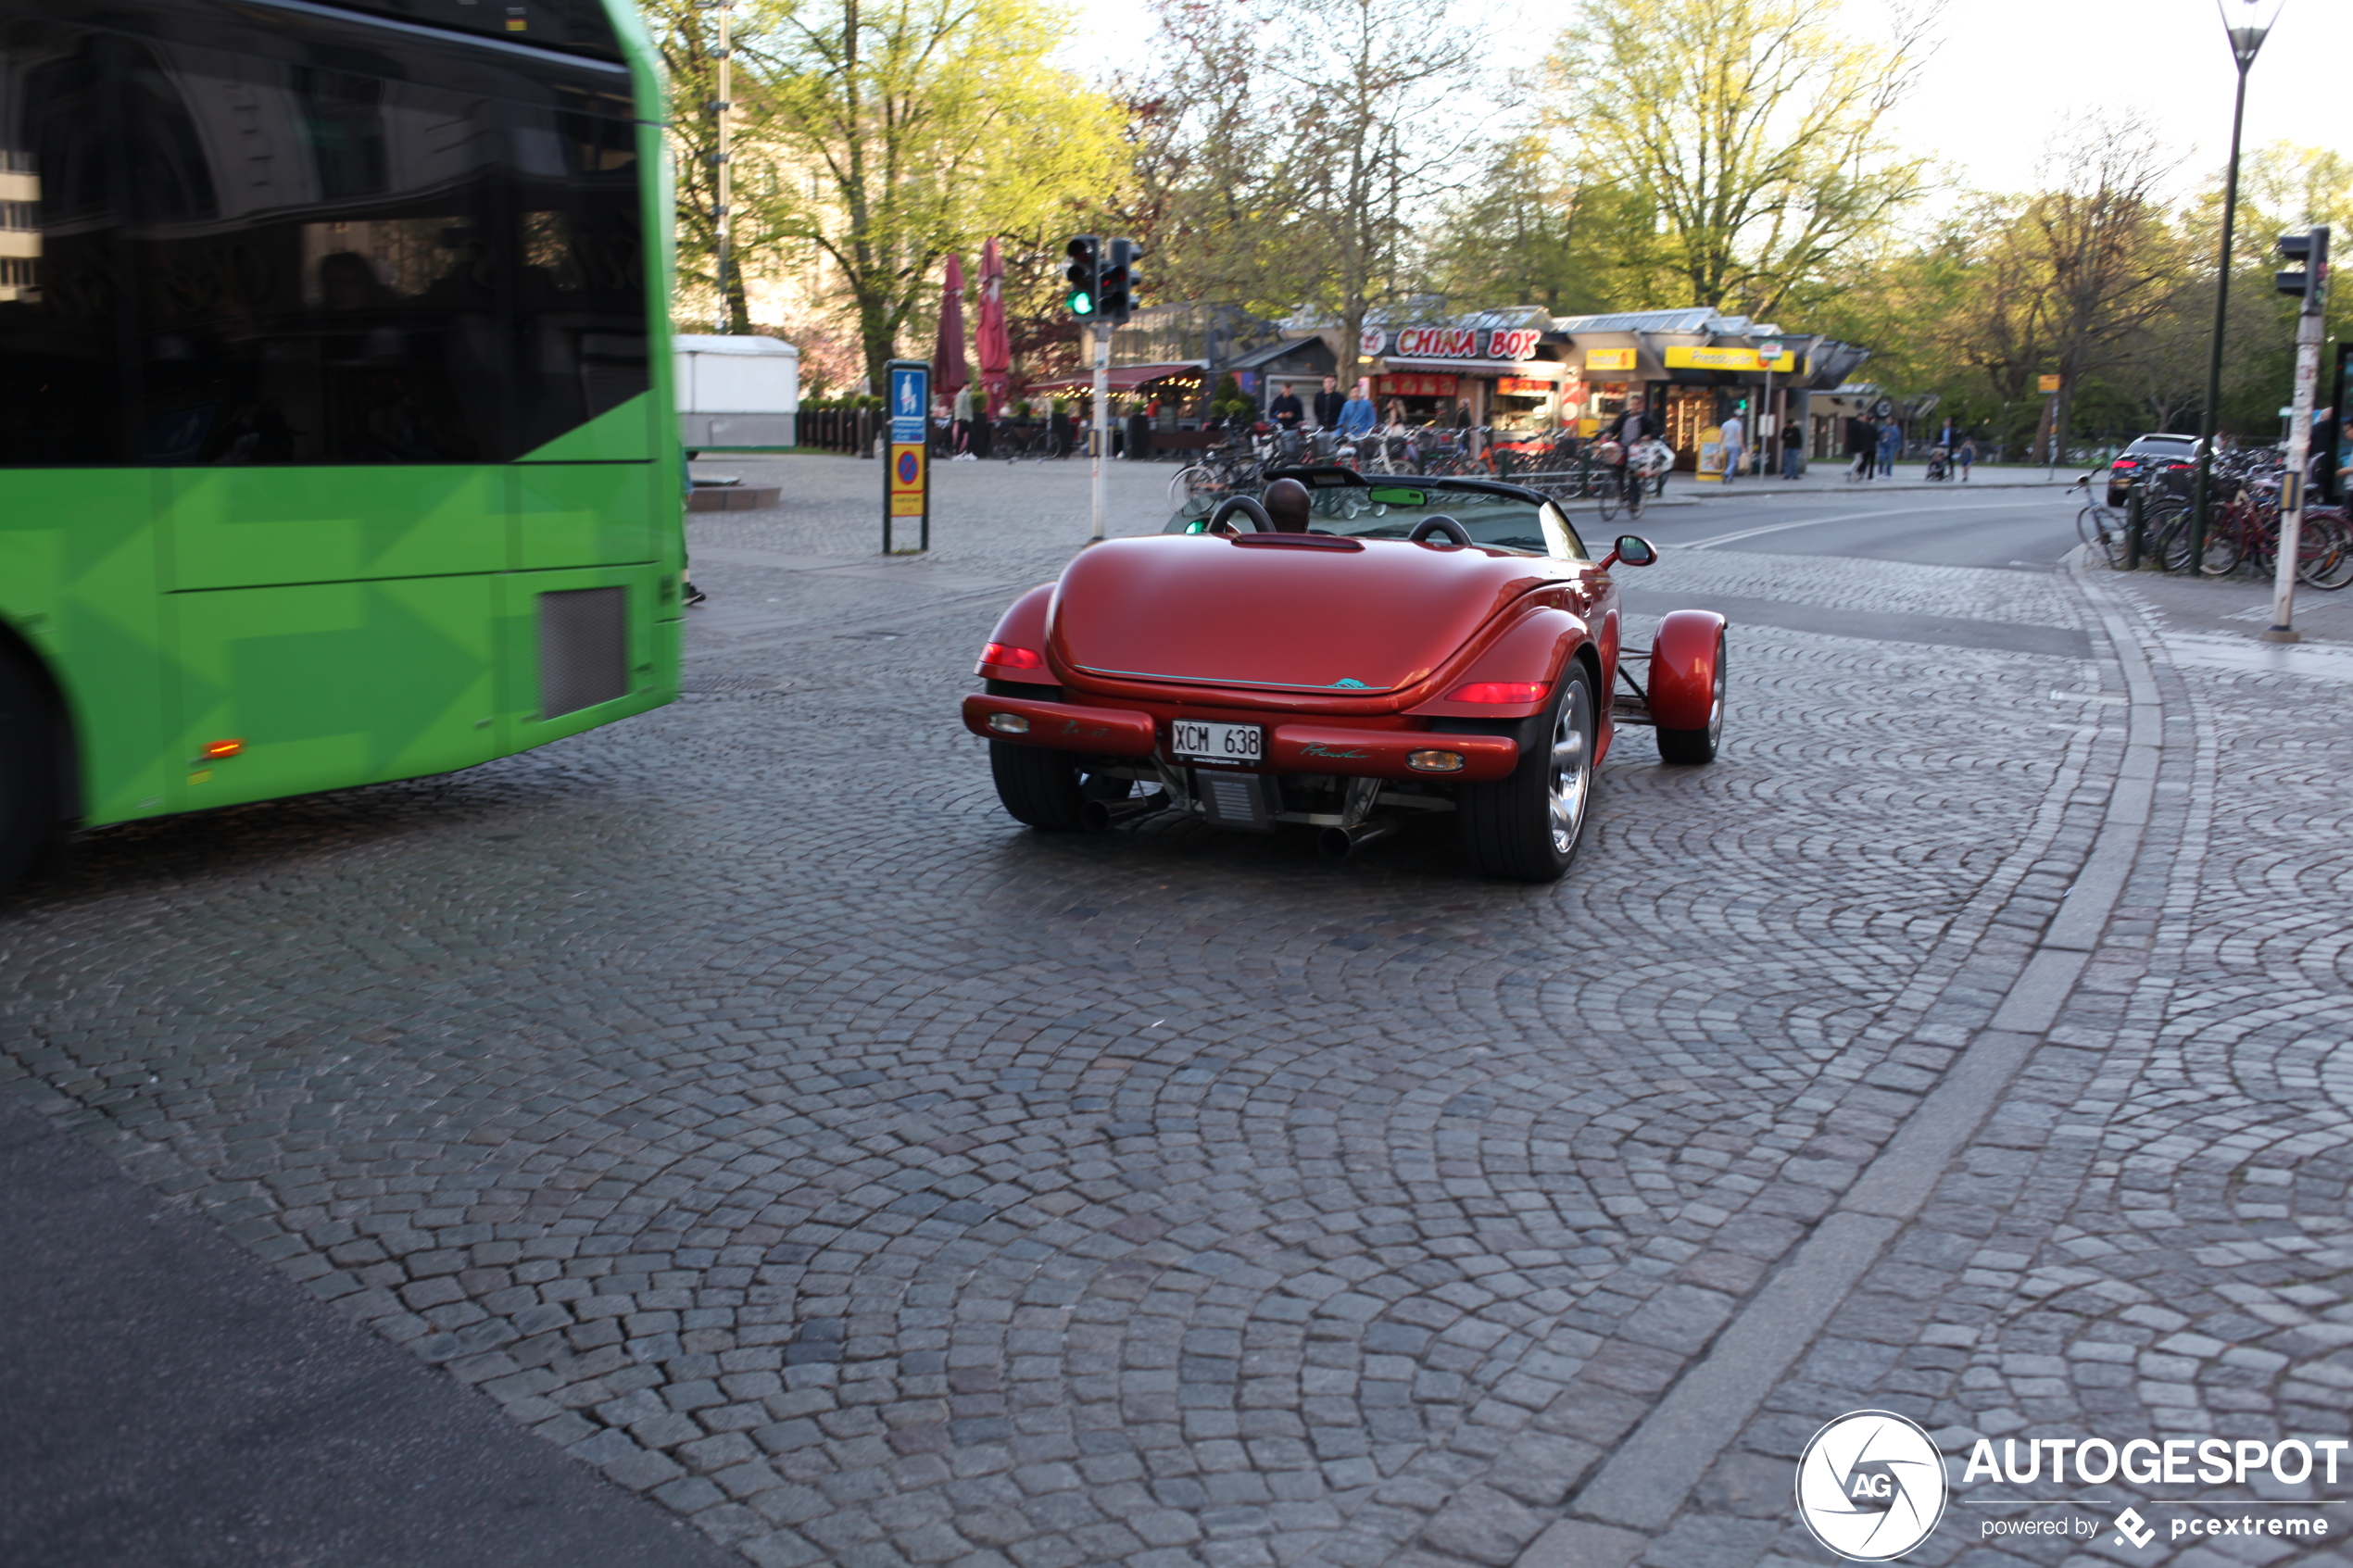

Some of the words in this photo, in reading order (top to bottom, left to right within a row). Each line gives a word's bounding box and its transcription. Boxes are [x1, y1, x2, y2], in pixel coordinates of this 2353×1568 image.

[1397, 327, 1478, 358] CHINA
[1488, 328, 1541, 362] BOX
[1176, 724, 1209, 752] XCM
[1225, 729, 1259, 755] 638
